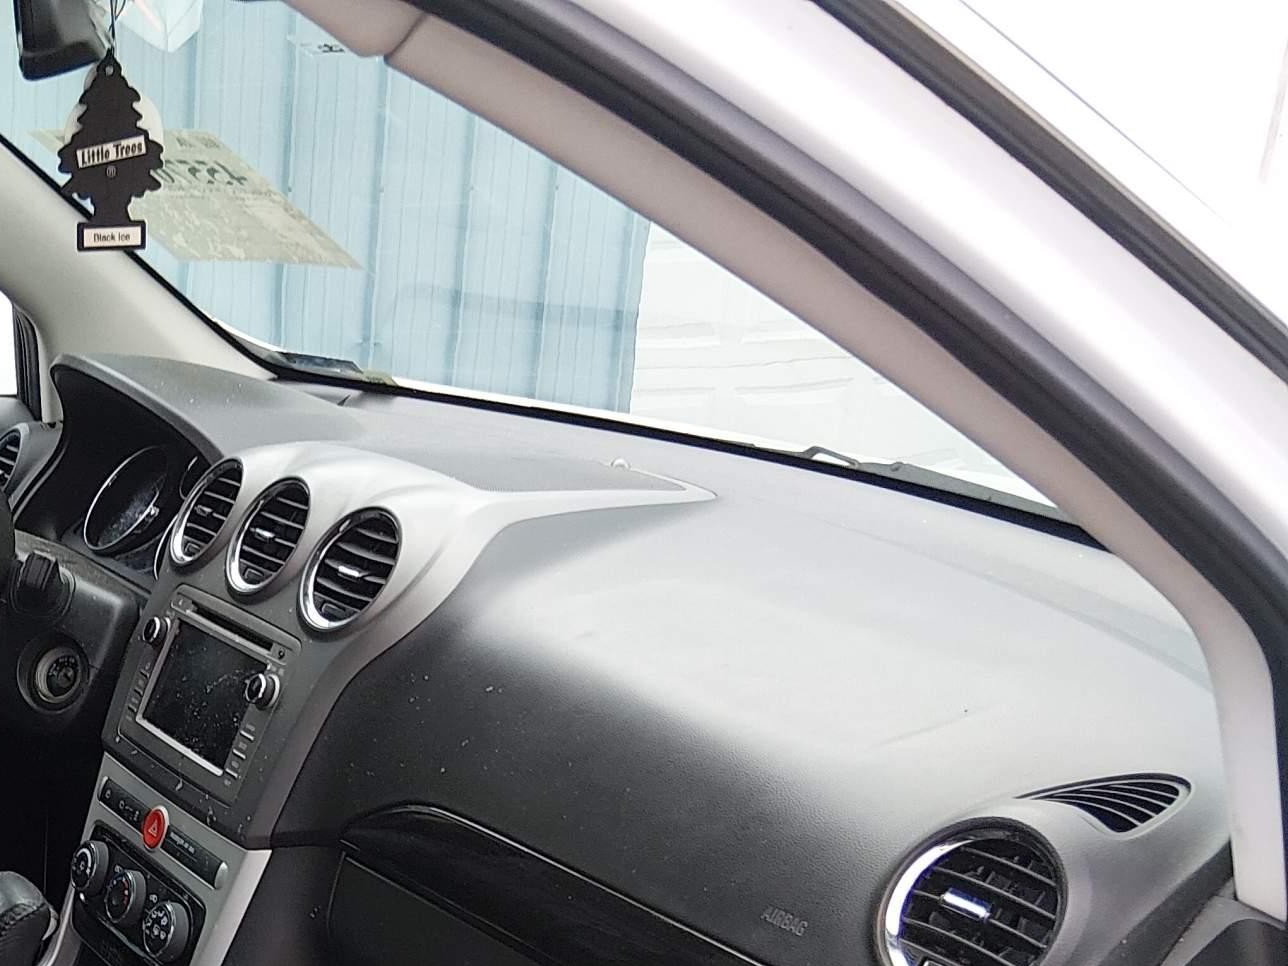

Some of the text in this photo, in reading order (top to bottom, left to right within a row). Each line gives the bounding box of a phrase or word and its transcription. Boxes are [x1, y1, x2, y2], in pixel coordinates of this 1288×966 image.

[81, 141, 144, 166] Little Trees
[93, 231, 131, 243] Black Ice
[760, 905, 809, 937] AIRBAG
